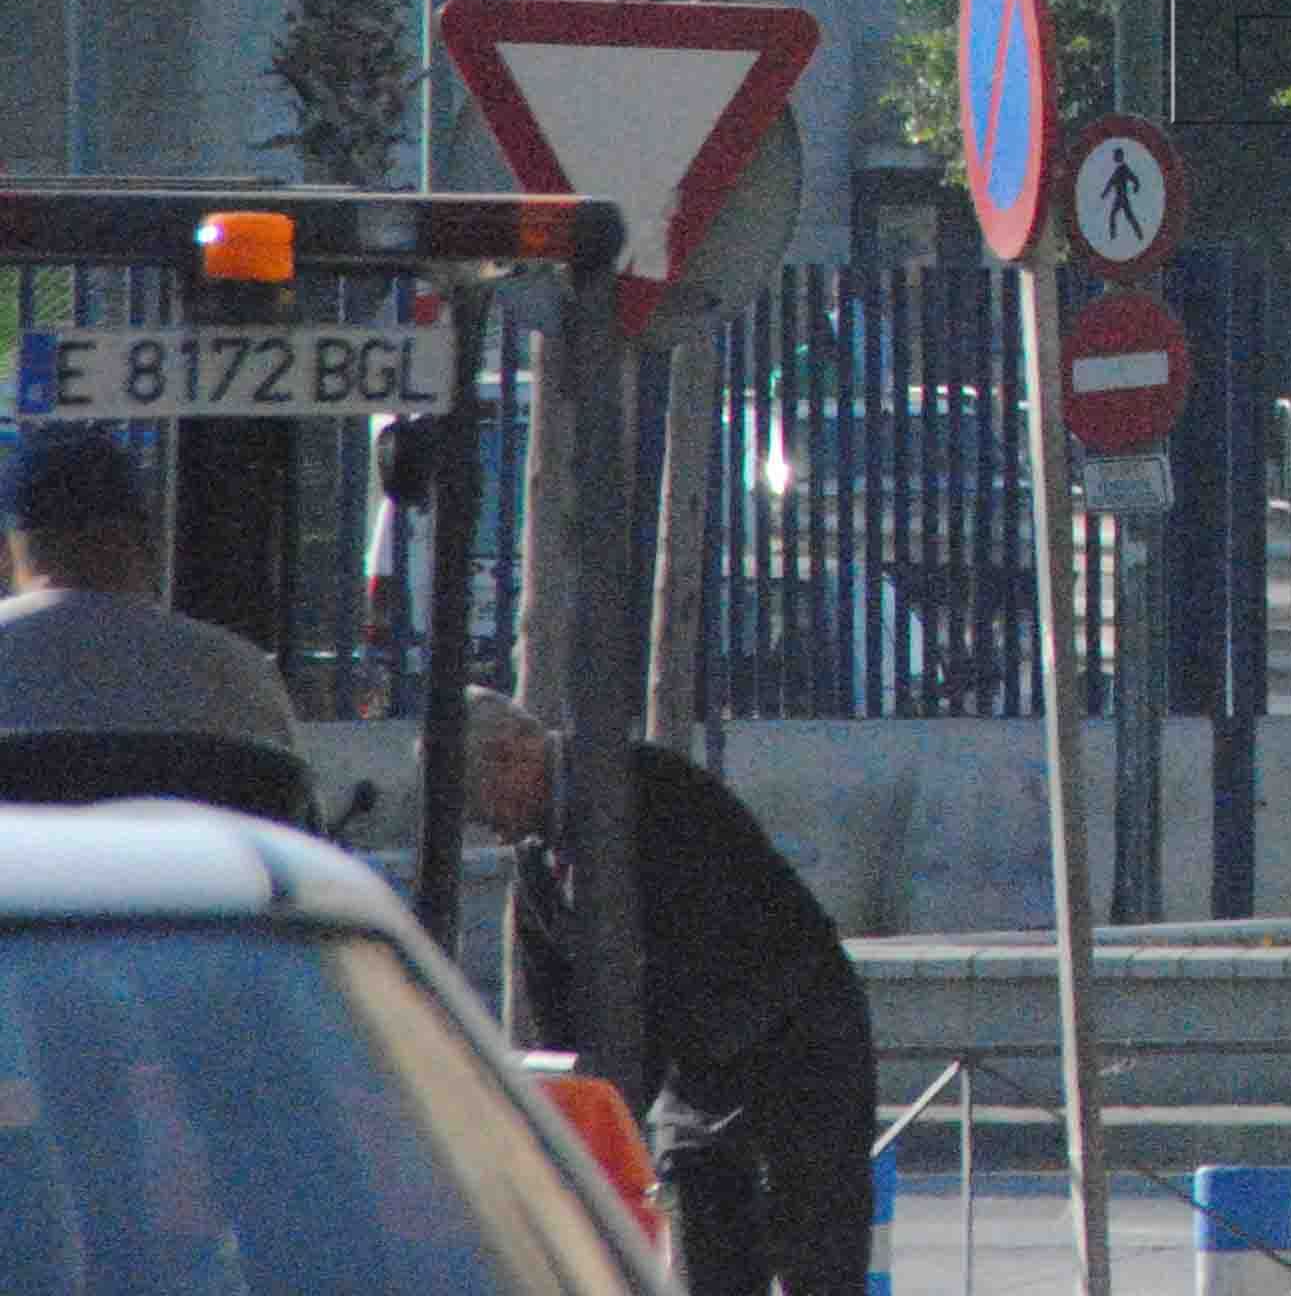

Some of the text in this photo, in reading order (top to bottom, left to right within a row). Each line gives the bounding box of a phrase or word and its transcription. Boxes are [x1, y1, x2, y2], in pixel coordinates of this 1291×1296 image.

[56, 337, 436, 405] E 8172 BGL
